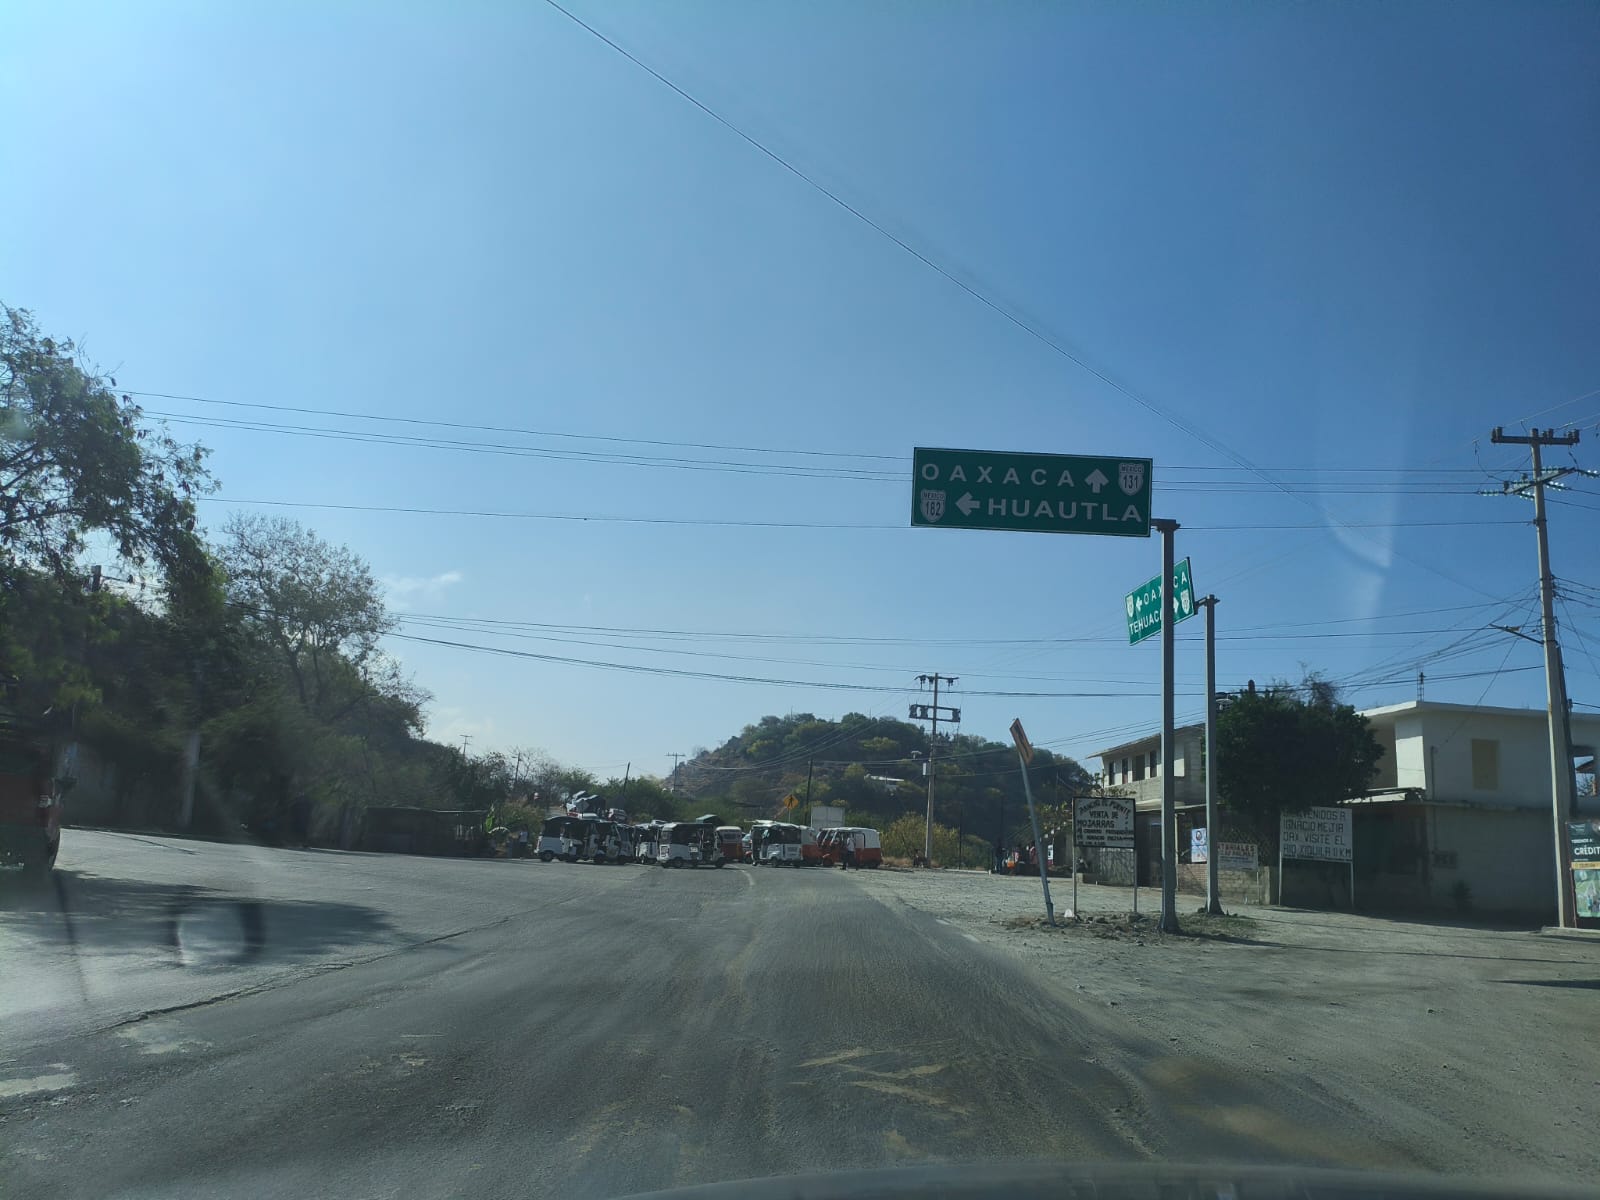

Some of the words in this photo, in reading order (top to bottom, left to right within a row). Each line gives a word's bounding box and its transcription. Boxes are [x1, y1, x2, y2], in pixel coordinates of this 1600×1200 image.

[921, 463, 1075, 488] OAXACA
[1123, 474, 1138, 489] 131
[926, 500, 941, 517] 182
[988, 498, 1142, 522] HUAUTLA
[1143, 571, 1187, 605] OAXCA
[1089, 810, 1109, 819] VENTA
[1283, 818, 1316, 831] IGNACIO
[1317, 822, 1344, 833] MEJIA
[1304, 832, 1330, 845] VISITE
[1335, 835, 1345, 846] EL
